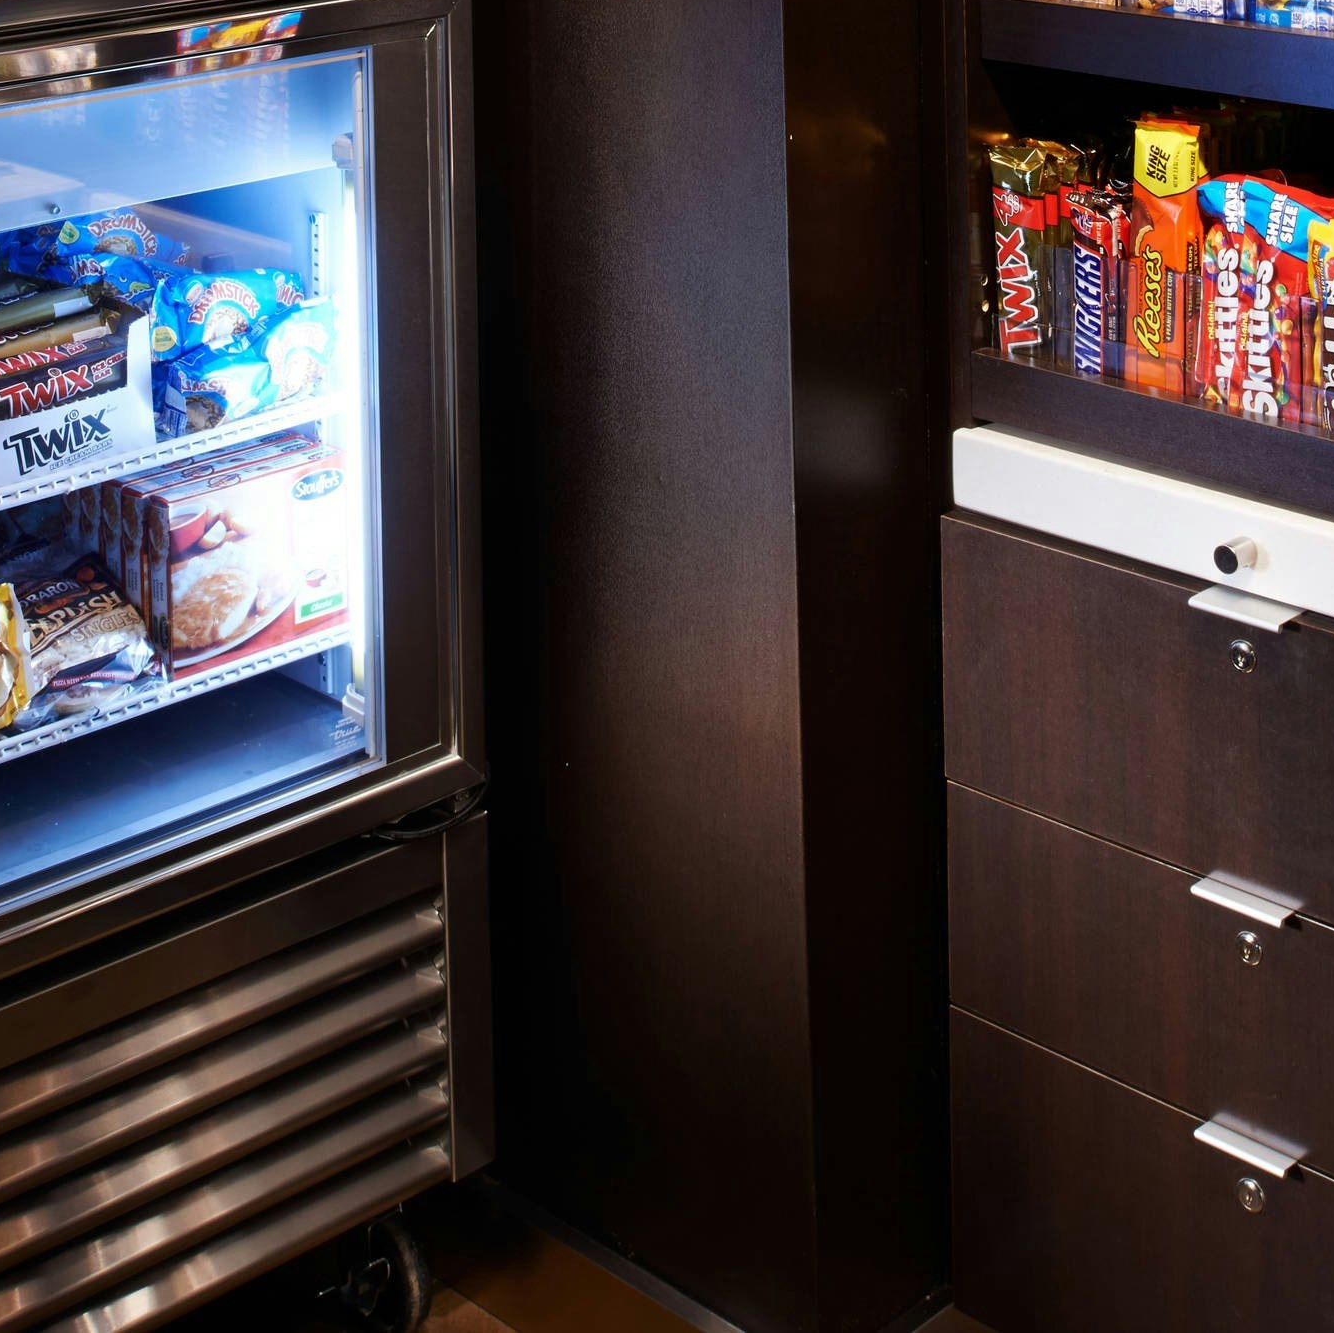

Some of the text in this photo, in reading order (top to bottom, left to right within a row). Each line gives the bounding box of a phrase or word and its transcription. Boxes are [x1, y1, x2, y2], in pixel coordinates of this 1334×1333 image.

[1145, 144, 1161, 180] KING
[1156, 148, 1170, 184] SIZE
[88, 213, 157, 257] DRUMSTICK
[1266, 194, 1287, 247] SHARE
[1280, 205, 1299, 244] SIZE
[189, 280, 260, 325] DRUMSTICK
[1133, 244, 1163, 358] Reese's
[1242, 259, 1279, 418] Skittles
[3, 408, 112, 476] Twix
[295, 470, 341, 499] Stouffer's
